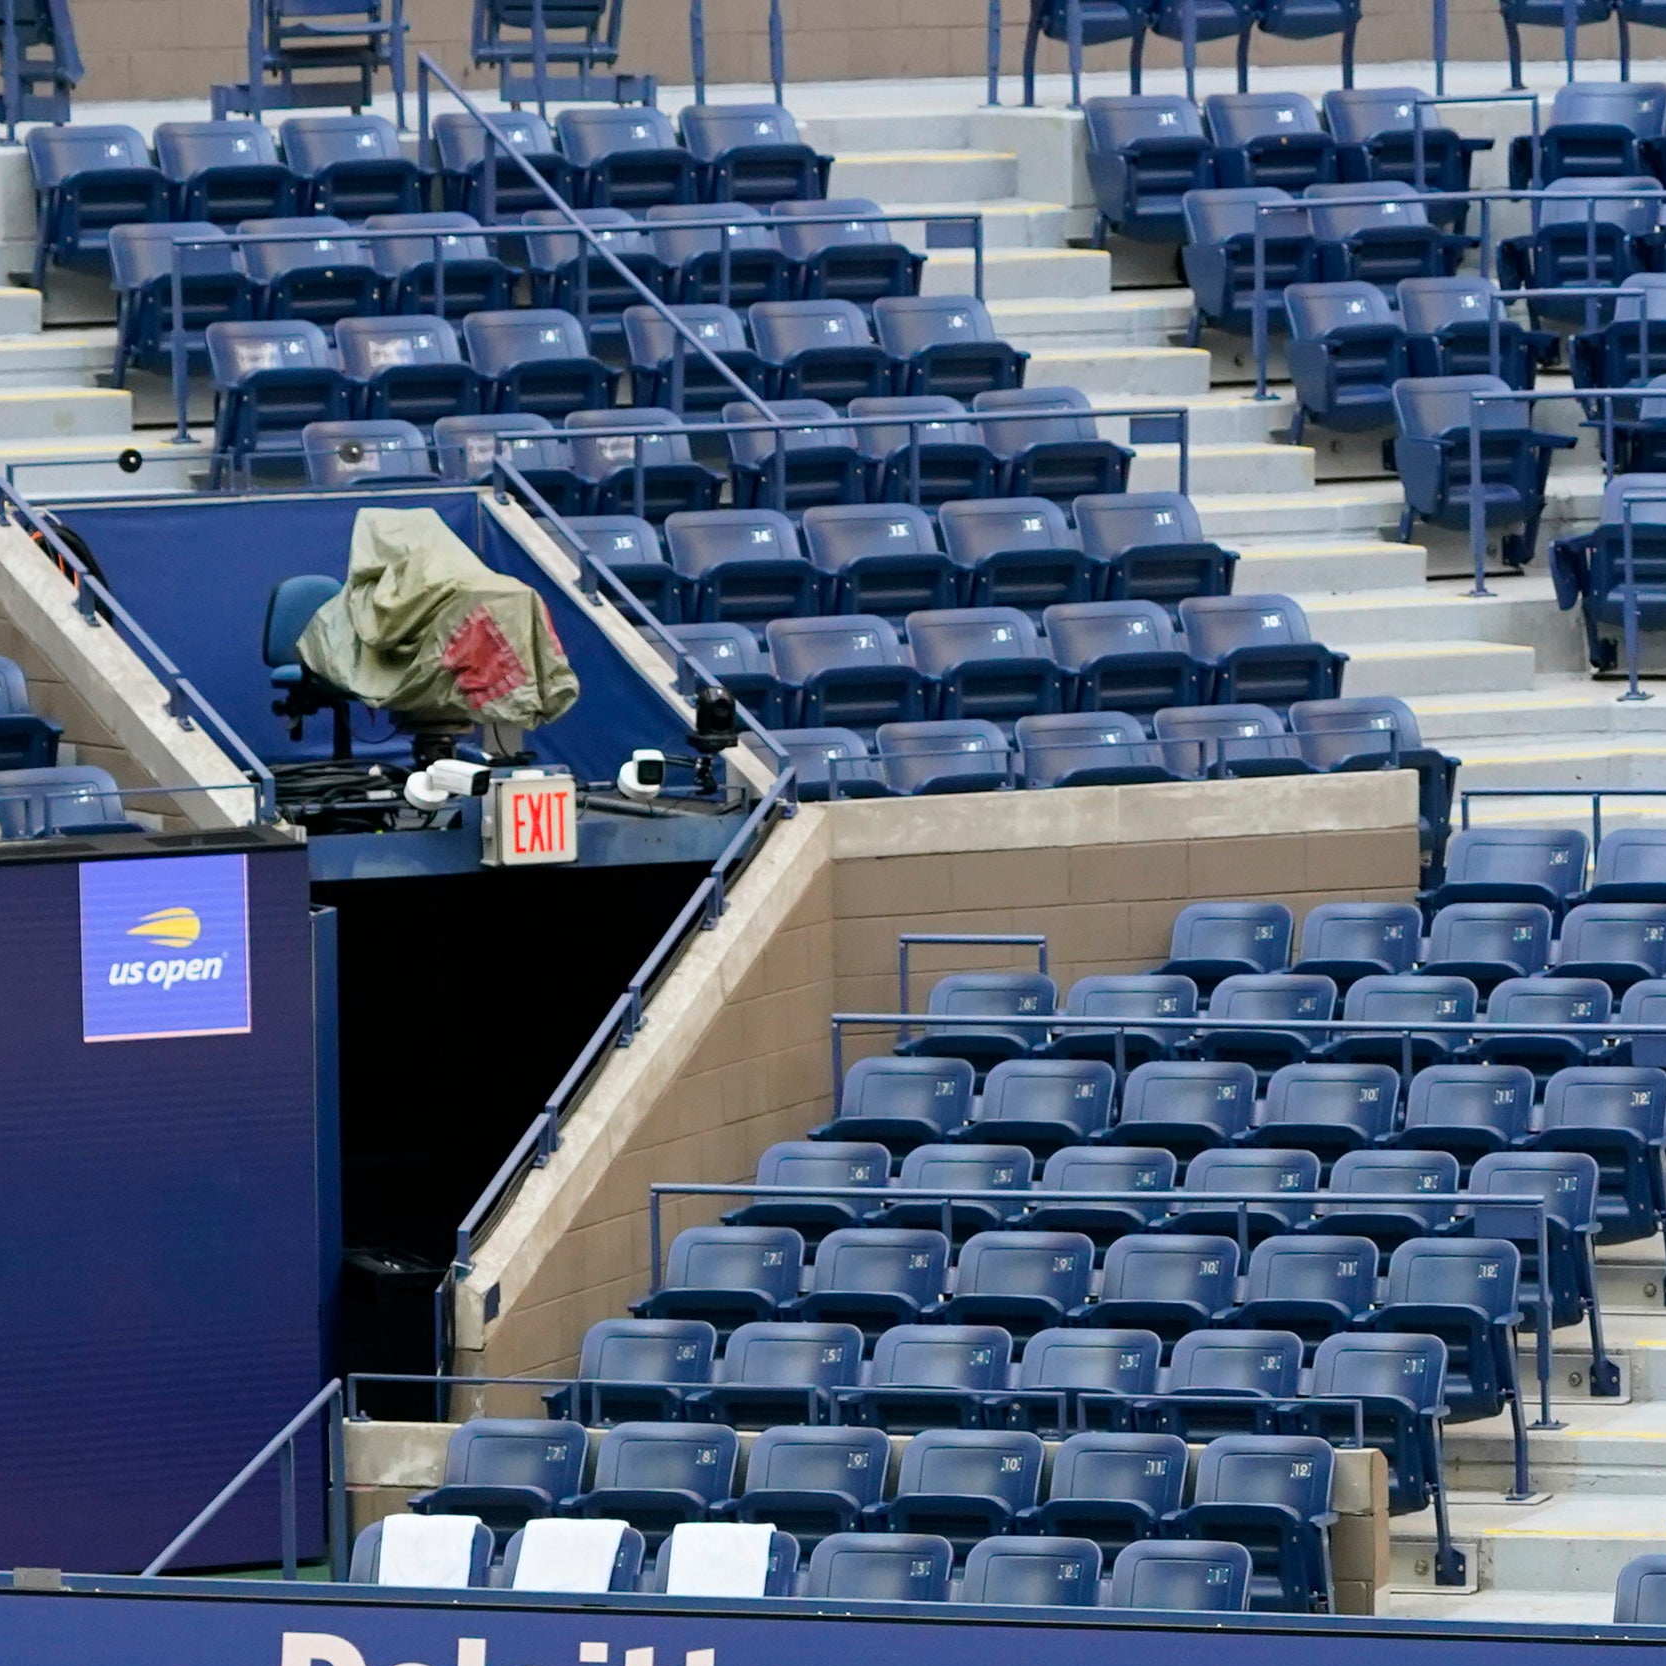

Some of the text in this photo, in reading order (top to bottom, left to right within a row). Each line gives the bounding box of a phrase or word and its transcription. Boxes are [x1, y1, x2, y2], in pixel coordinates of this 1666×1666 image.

[513, 792, 568, 853] EXIT
[109, 957, 223, 990] us open
